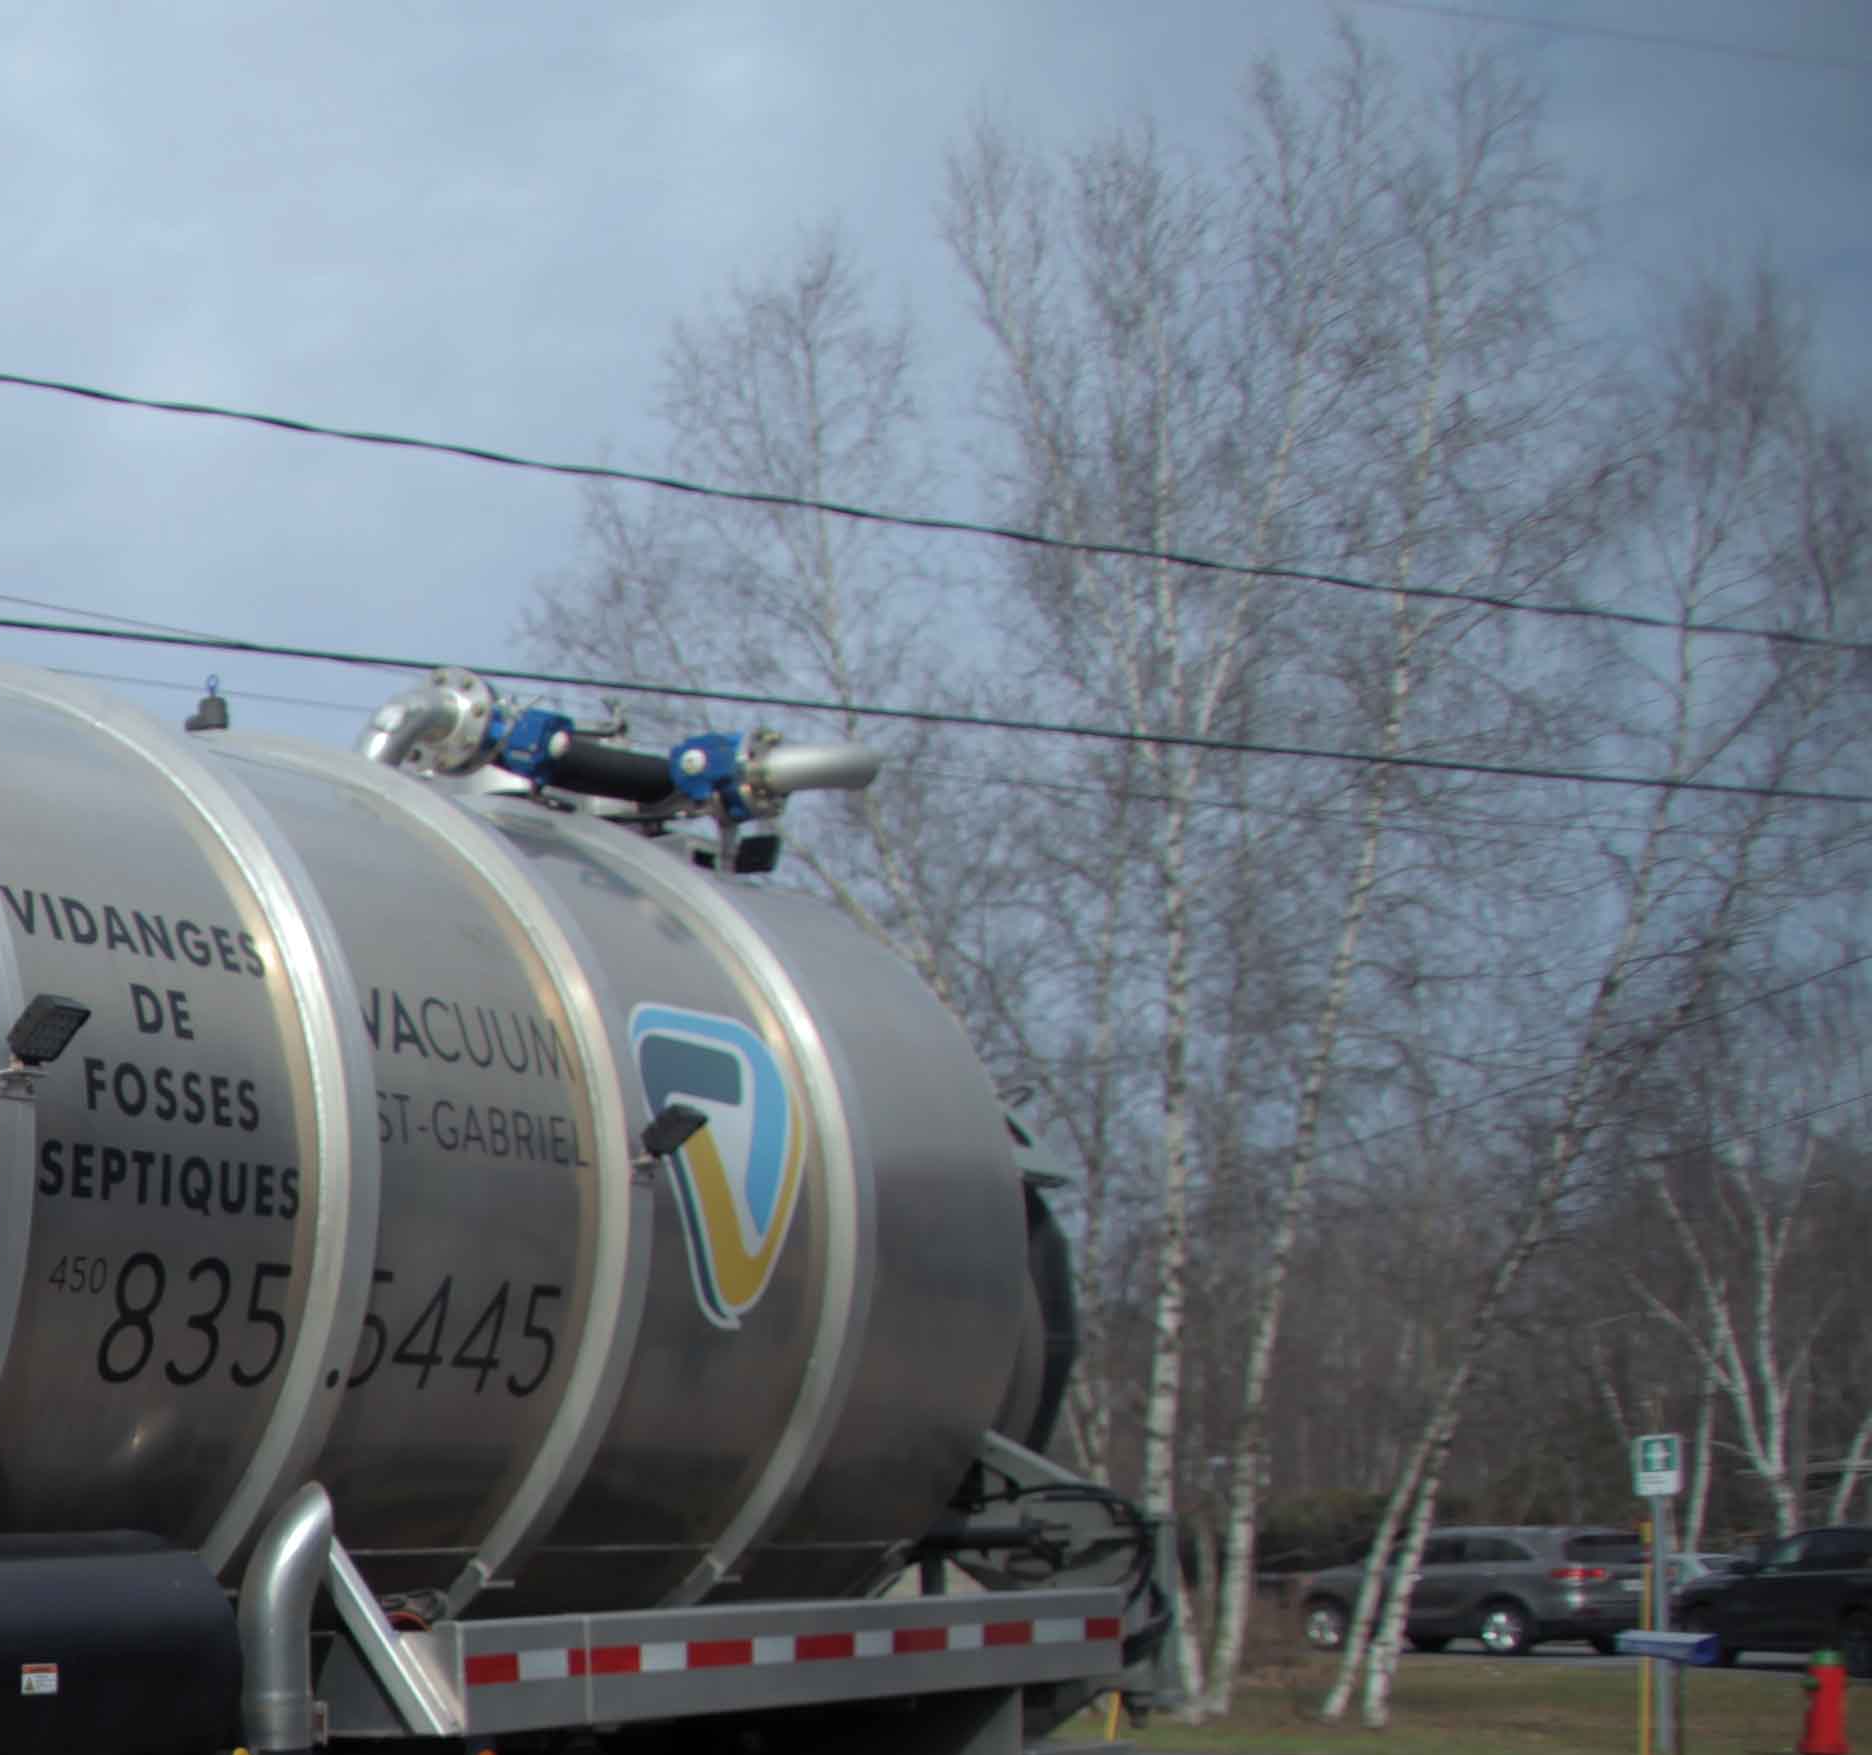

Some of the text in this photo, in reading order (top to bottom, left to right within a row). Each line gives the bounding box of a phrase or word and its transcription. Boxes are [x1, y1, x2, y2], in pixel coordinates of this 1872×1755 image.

[0, 885, 267, 979] VIDANGES
[129, 983, 195, 1040] DE
[360, 987, 578, 1083] VACUUM
[84, 1057, 260, 1131] FOSSES
[375, 1088, 591, 1168] ST-GABRIEL
[38, 1139, 300, 1220] SEPTIQUES
[48, 1254, 108, 1296] 450
